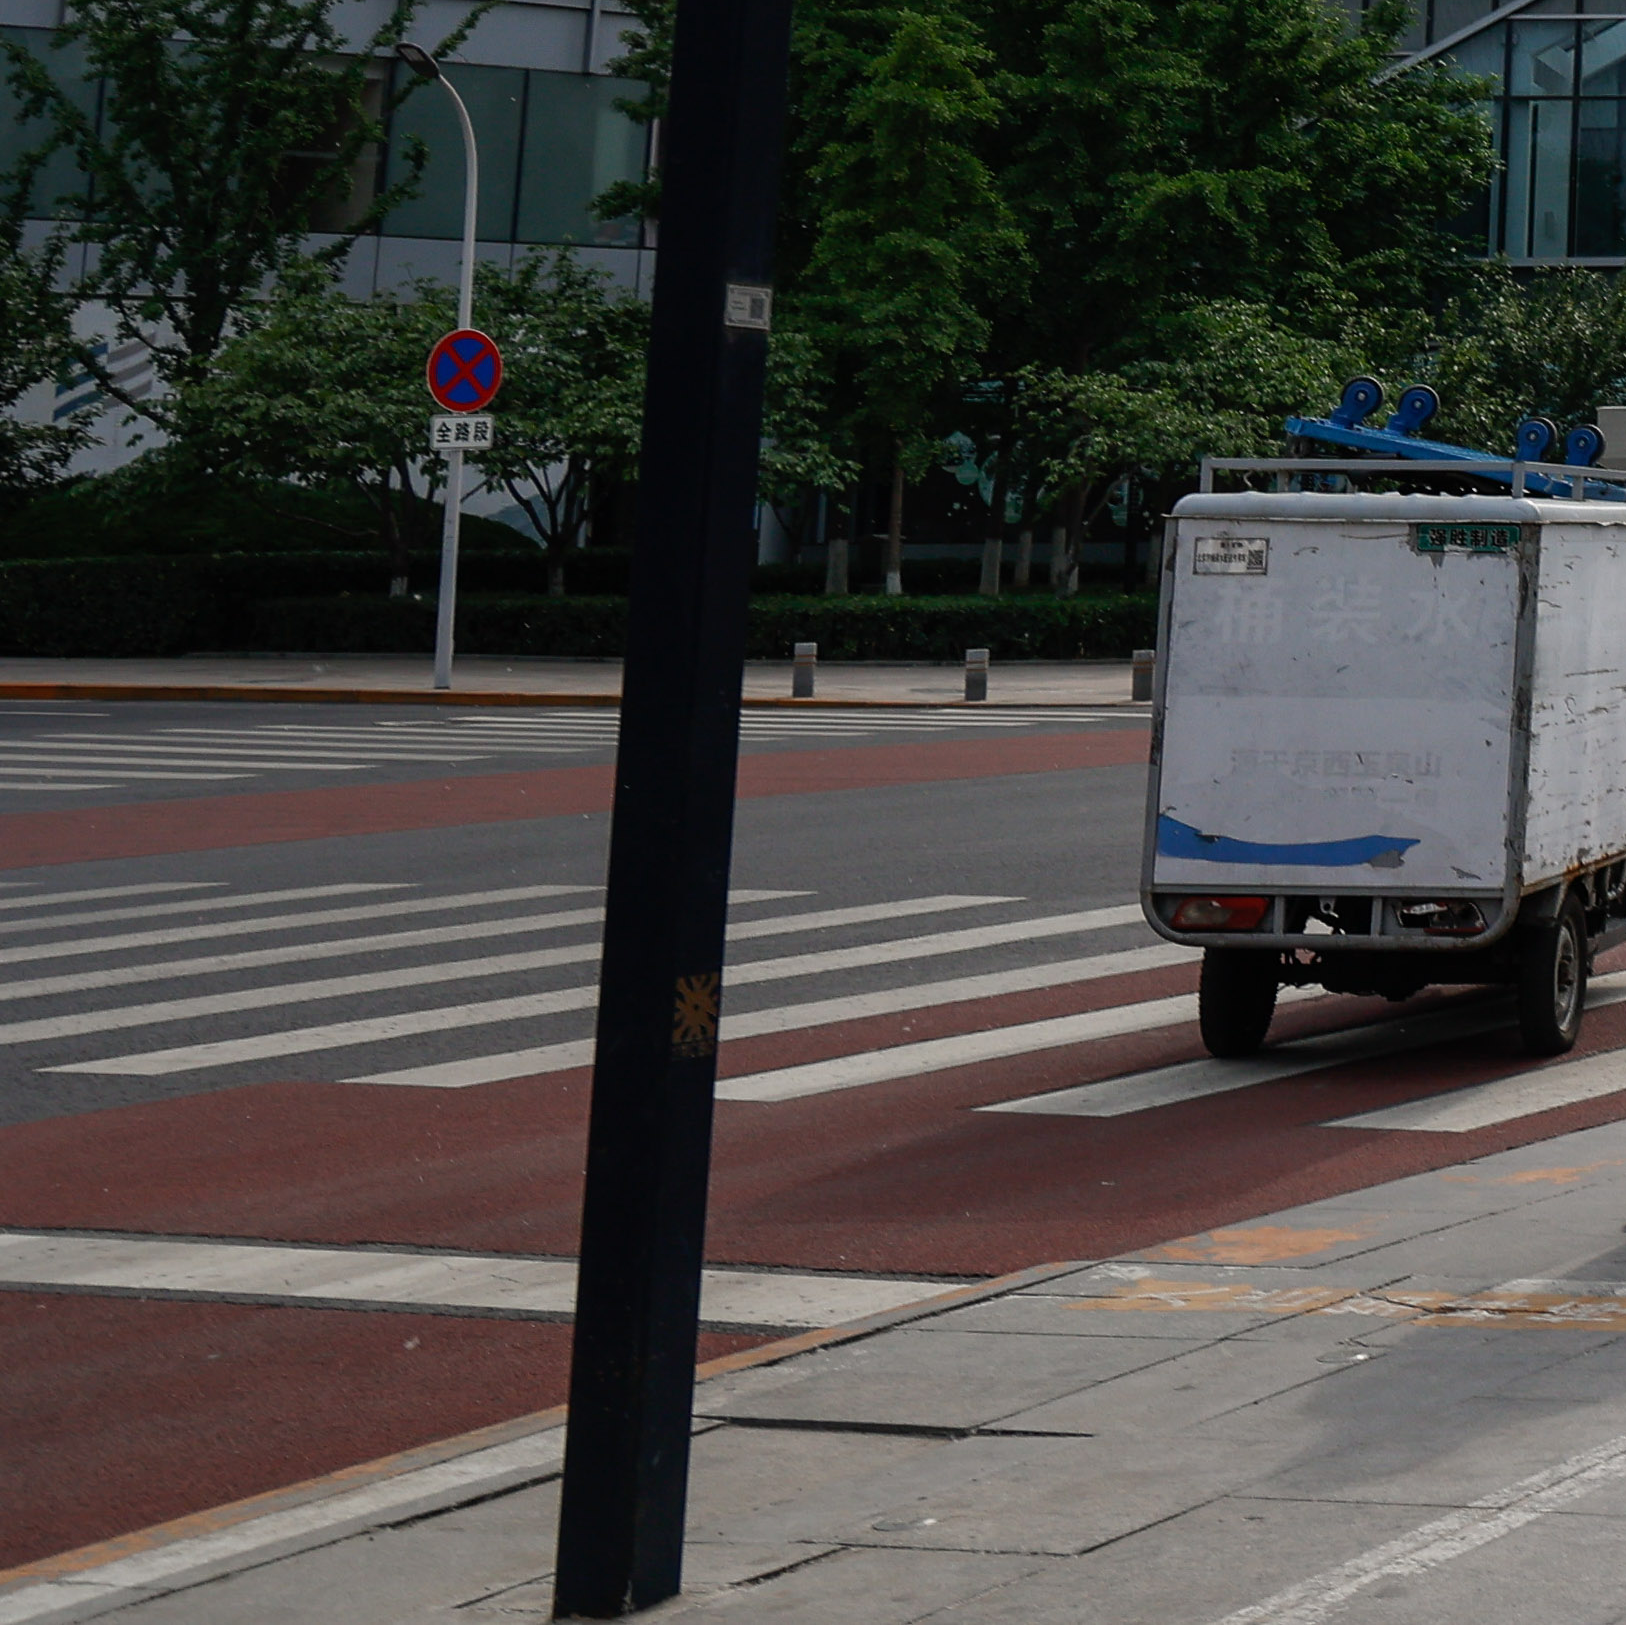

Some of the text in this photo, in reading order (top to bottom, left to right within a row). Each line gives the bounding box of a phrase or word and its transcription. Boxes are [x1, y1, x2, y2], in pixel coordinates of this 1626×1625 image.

[435, 420, 490, 444] 全路段
[1213, 576, 1477, 646] 桶装水
